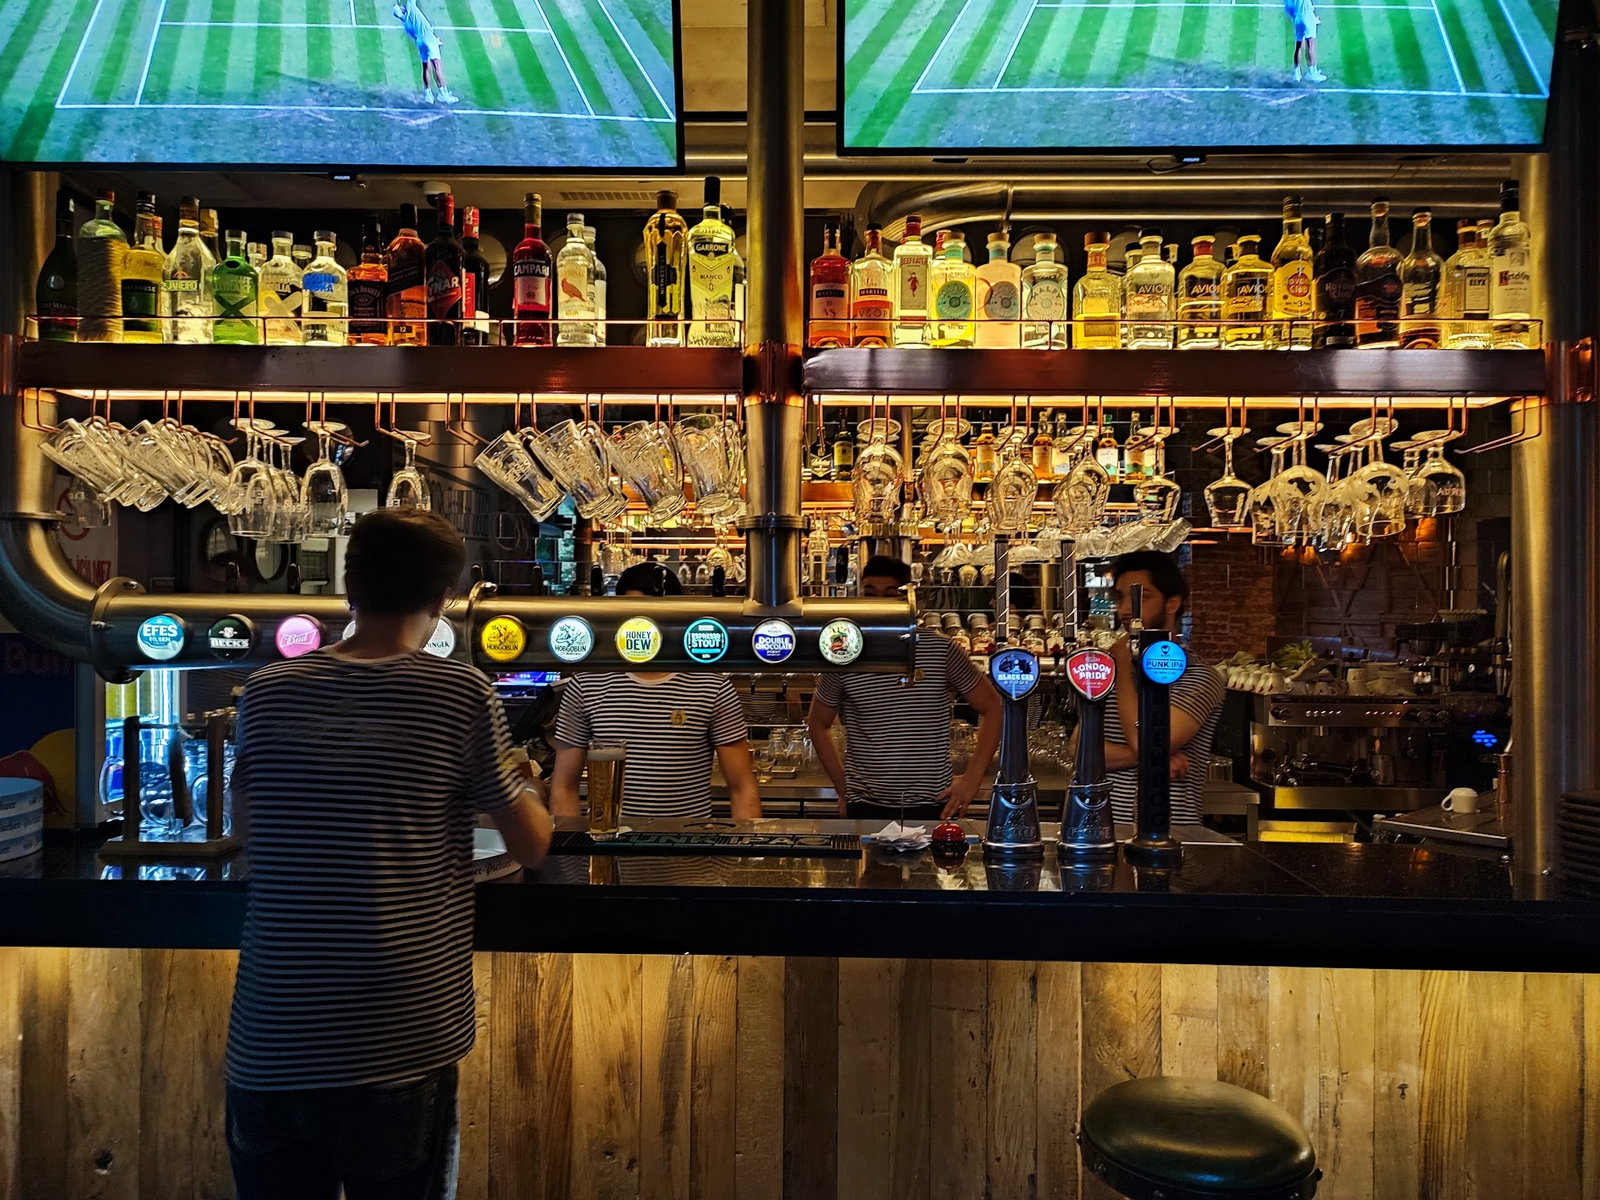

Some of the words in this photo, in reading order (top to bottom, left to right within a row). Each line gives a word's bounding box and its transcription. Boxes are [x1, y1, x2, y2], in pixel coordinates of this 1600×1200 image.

[695, 242, 728, 253] GARRONE
[513, 264, 550, 278] CAMPARI
[166, 280, 198, 291] JANEIRO
[143, 624, 179, 638] EFES
[625, 631, 652, 641] HONEY
[286, 632, 311, 646] Bud
[691, 632, 722, 641] ESPRESSO
[758, 636, 791, 645] DOUBLE
[486, 643, 520, 653] HOBGOBLIN
[554, 644, 588, 653] HOBGOBLIN
[625, 640, 652, 651] DEW
[691, 639, 721, 649] STOUT
[755, 643, 794, 651] CHOCOLATE
[1072, 662, 1112, 676] LONDON
[1146, 661, 1169, 669] PUNK
[1171, 661, 1184, 669] IPA
[998, 673, 1020, 681] BLACK
[1079, 671, 1107, 681] PRIDE
